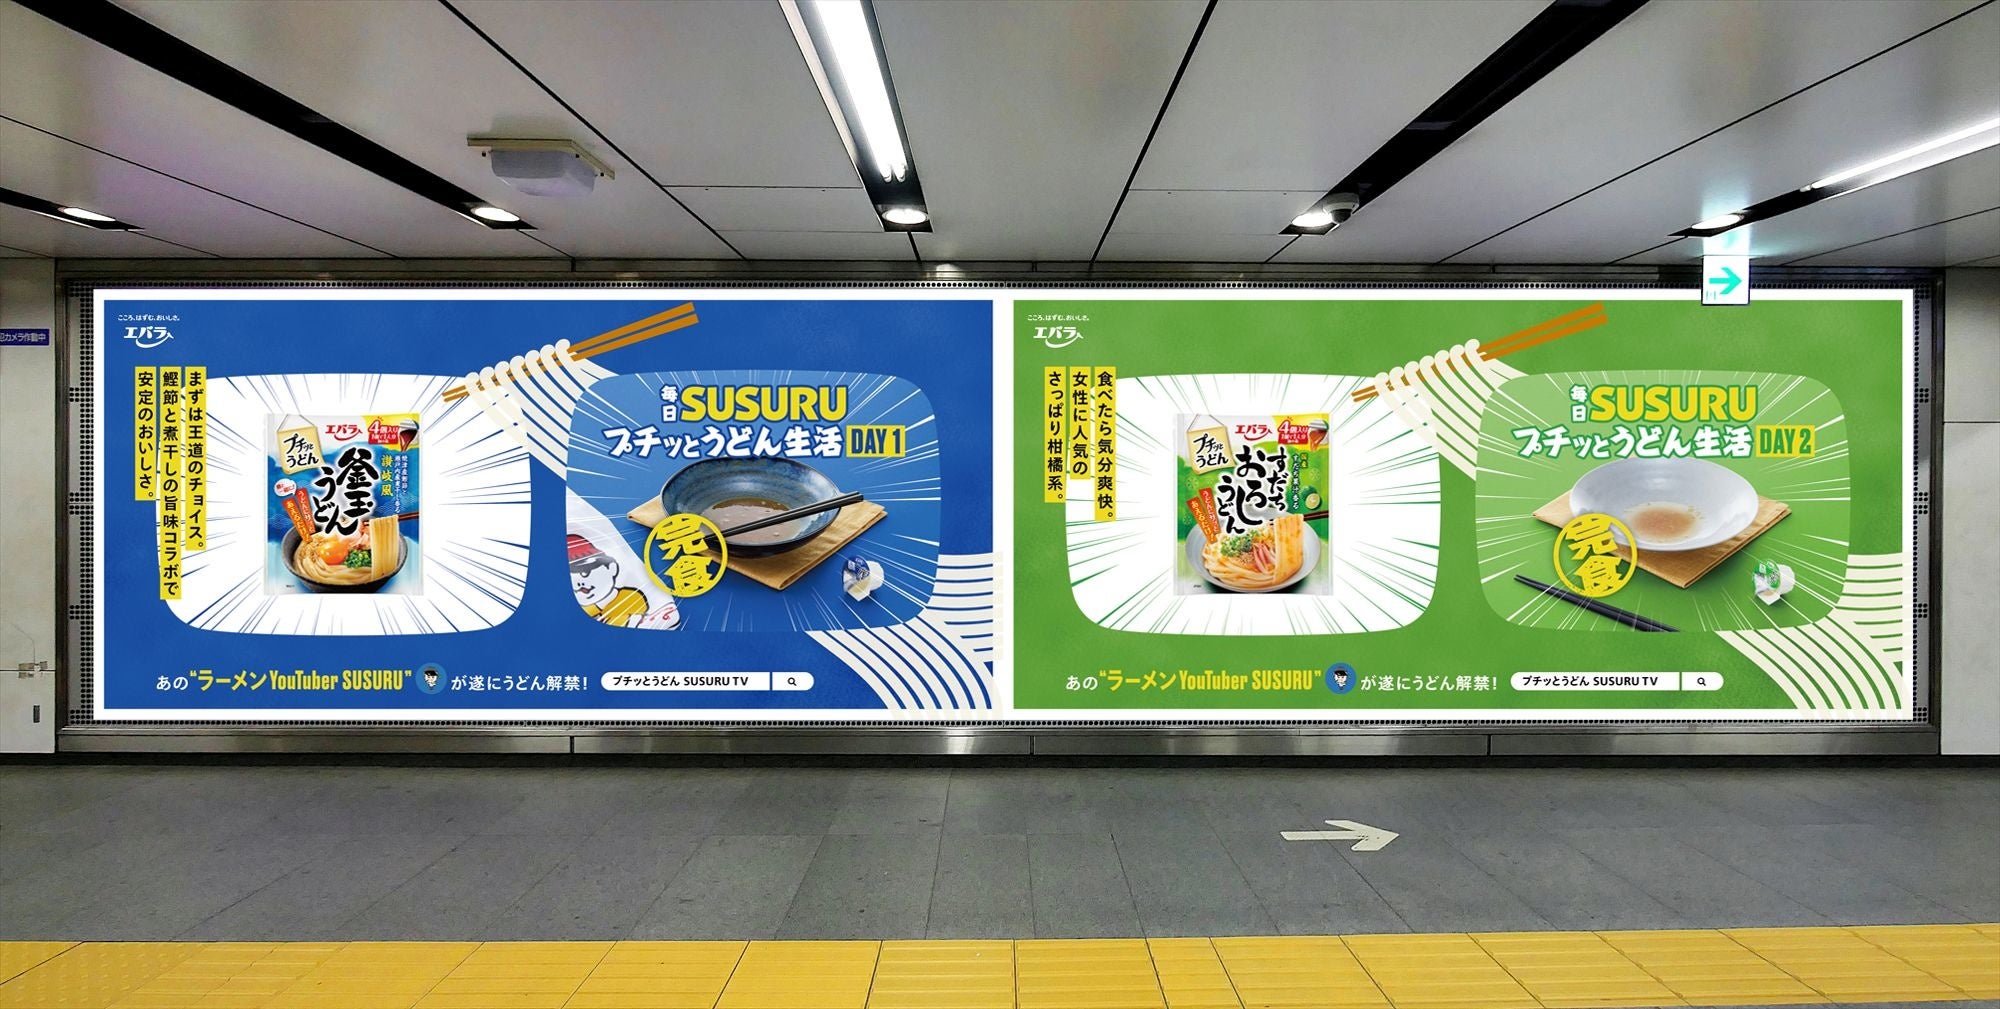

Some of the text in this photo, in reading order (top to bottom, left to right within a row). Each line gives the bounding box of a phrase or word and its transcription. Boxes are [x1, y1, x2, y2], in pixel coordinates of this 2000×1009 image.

[117, 314, 180, 322] こころ、はずむ、おいしさ。
[1027, 314, 1090, 322] こころ、はずむ、おいしさ。
[123, 326, 174, 349] エバラ
[1033, 326, 1084, 349] エバラ
[660, 385, 678, 422] 毎日
[680, 385, 847, 422] SUSURU
[1569, 385, 1587, 422] 毎日
[1590, 385, 1757, 422] SUSURU
[138, 371, 154, 498] 安定のおいしさ。
[325, 424, 363, 441] エバラ
[603, 424, 902, 459] プチッとうどん生活 DAY 1
[1047, 371, 1064, 500] さっぱり柑橘系。
[1073, 371, 1088, 476] 女性に人気の
[1235, 424, 1273, 441] エバラ
[1513, 424, 1812, 459] プチッとうどん生活 DAY 2
[188, 371, 204, 548] まずは王道のチョイス。
[283, 433, 314, 455] プチッと
[286, 454, 319, 468] うどん
[1098, 371, 1113, 519] 食べたら気分爽快。
[1193, 433, 1224, 455] プチッと
[1196, 454, 1229, 468] うどん
[163, 371, 179, 597] 鰹節と煮干しの旨味コラボで
[338, 446, 379, 516] 釜玉
[381, 455, 394, 497] 讃岐風
[1236, 444, 1268, 526] おろし
[1266, 446, 1288, 512] すだち
[314, 466, 359, 535] うどん
[1217, 474, 1246, 535] うどん
[655, 516, 714, 594] 完食
[1565, 516, 1623, 594] 完食
[270, 670, 338, 691] YouTuber
[451, 674, 588, 692] が遂にうどん解禁!
[613, 675, 749, 687] プチッとうどん SUSURU TV
[1179, 670, 1248, 691] YouTuber
[1360, 674, 1498, 692] が遂にうどん解禁!
[1522, 675, 1658, 687] プチッとうどん SUSURU TV
